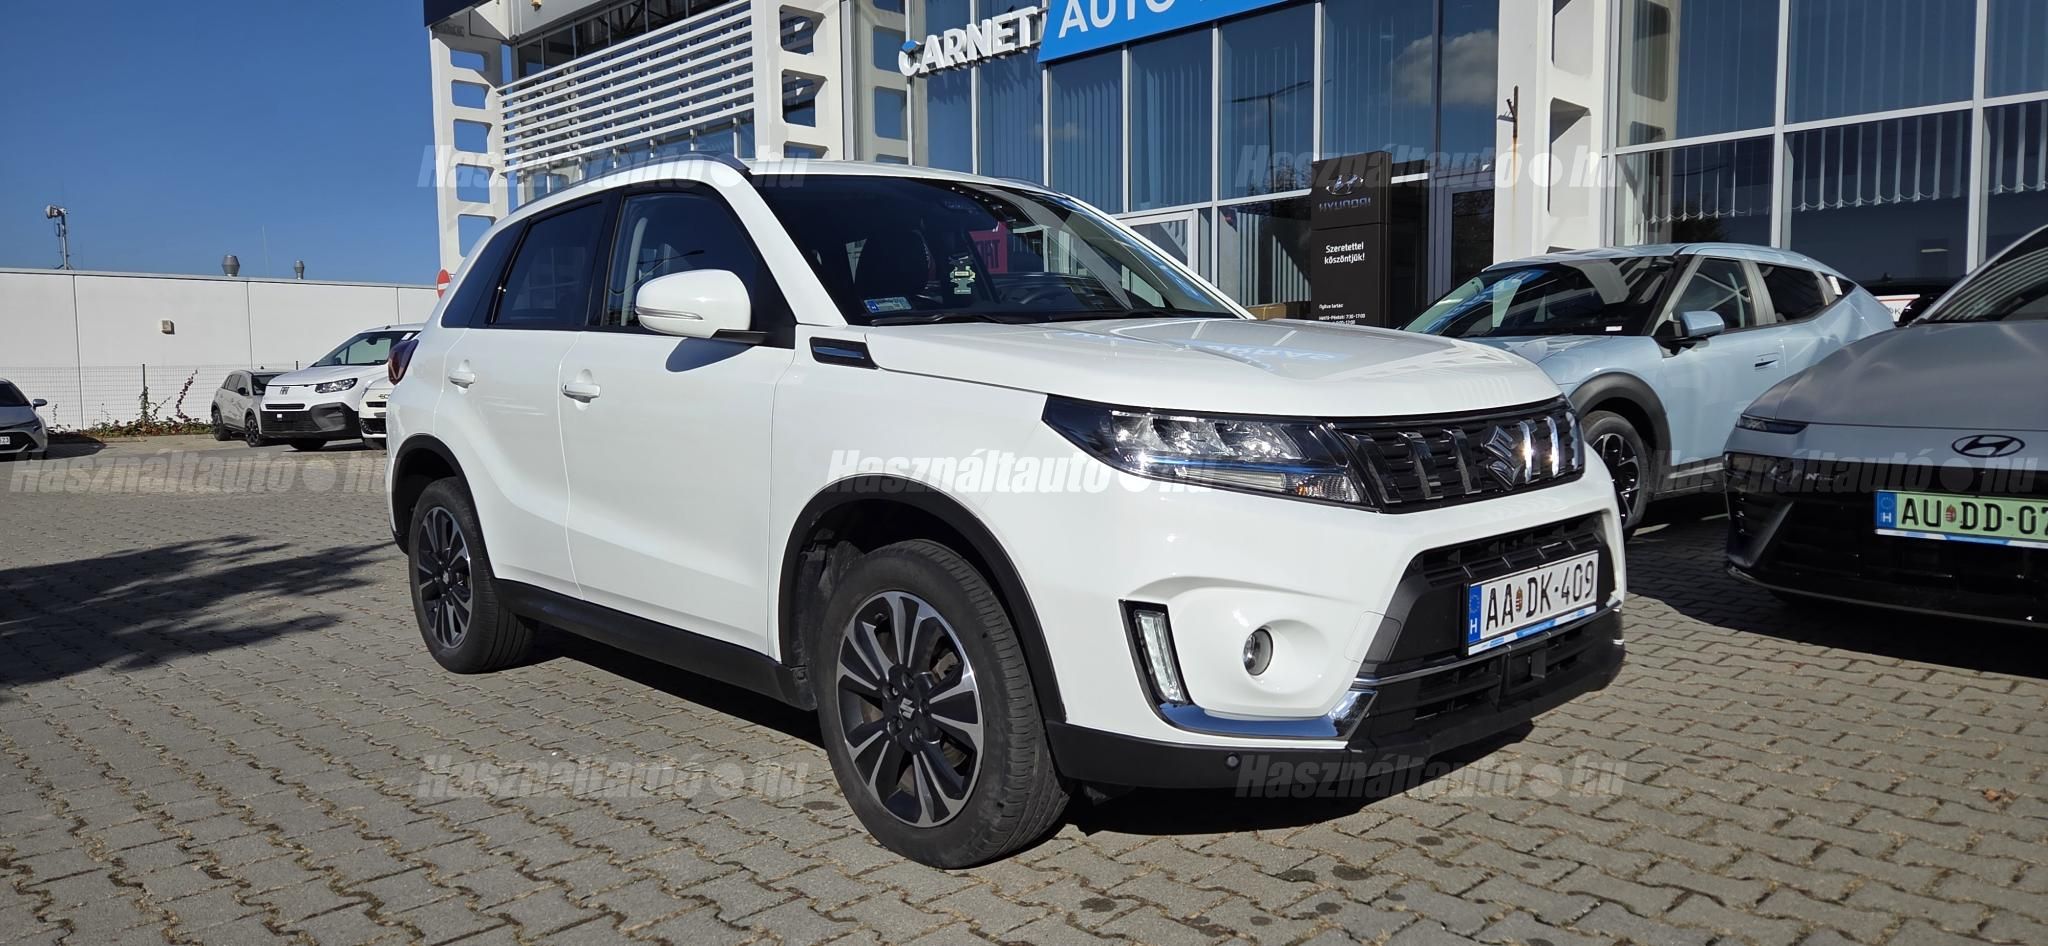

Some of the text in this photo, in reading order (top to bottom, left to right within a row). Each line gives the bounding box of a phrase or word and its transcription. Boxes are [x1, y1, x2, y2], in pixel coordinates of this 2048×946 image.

[1058, 0, 1175, 38] AU
[898, 5, 1038, 77] CARNET
[1319, 197, 1371, 211] HYUNDAI
[1325, 241, 1364, 254] Szeretettel
[1324, 252, 1366, 265] köszöntjük!
[1882, 512, 1892, 523] H
[1901, 498, 1942, 528] AU
[1486, 583, 1514, 631] AA
[1526, 560, 1594, 618] DK-409
[1469, 617, 1478, 635] H
